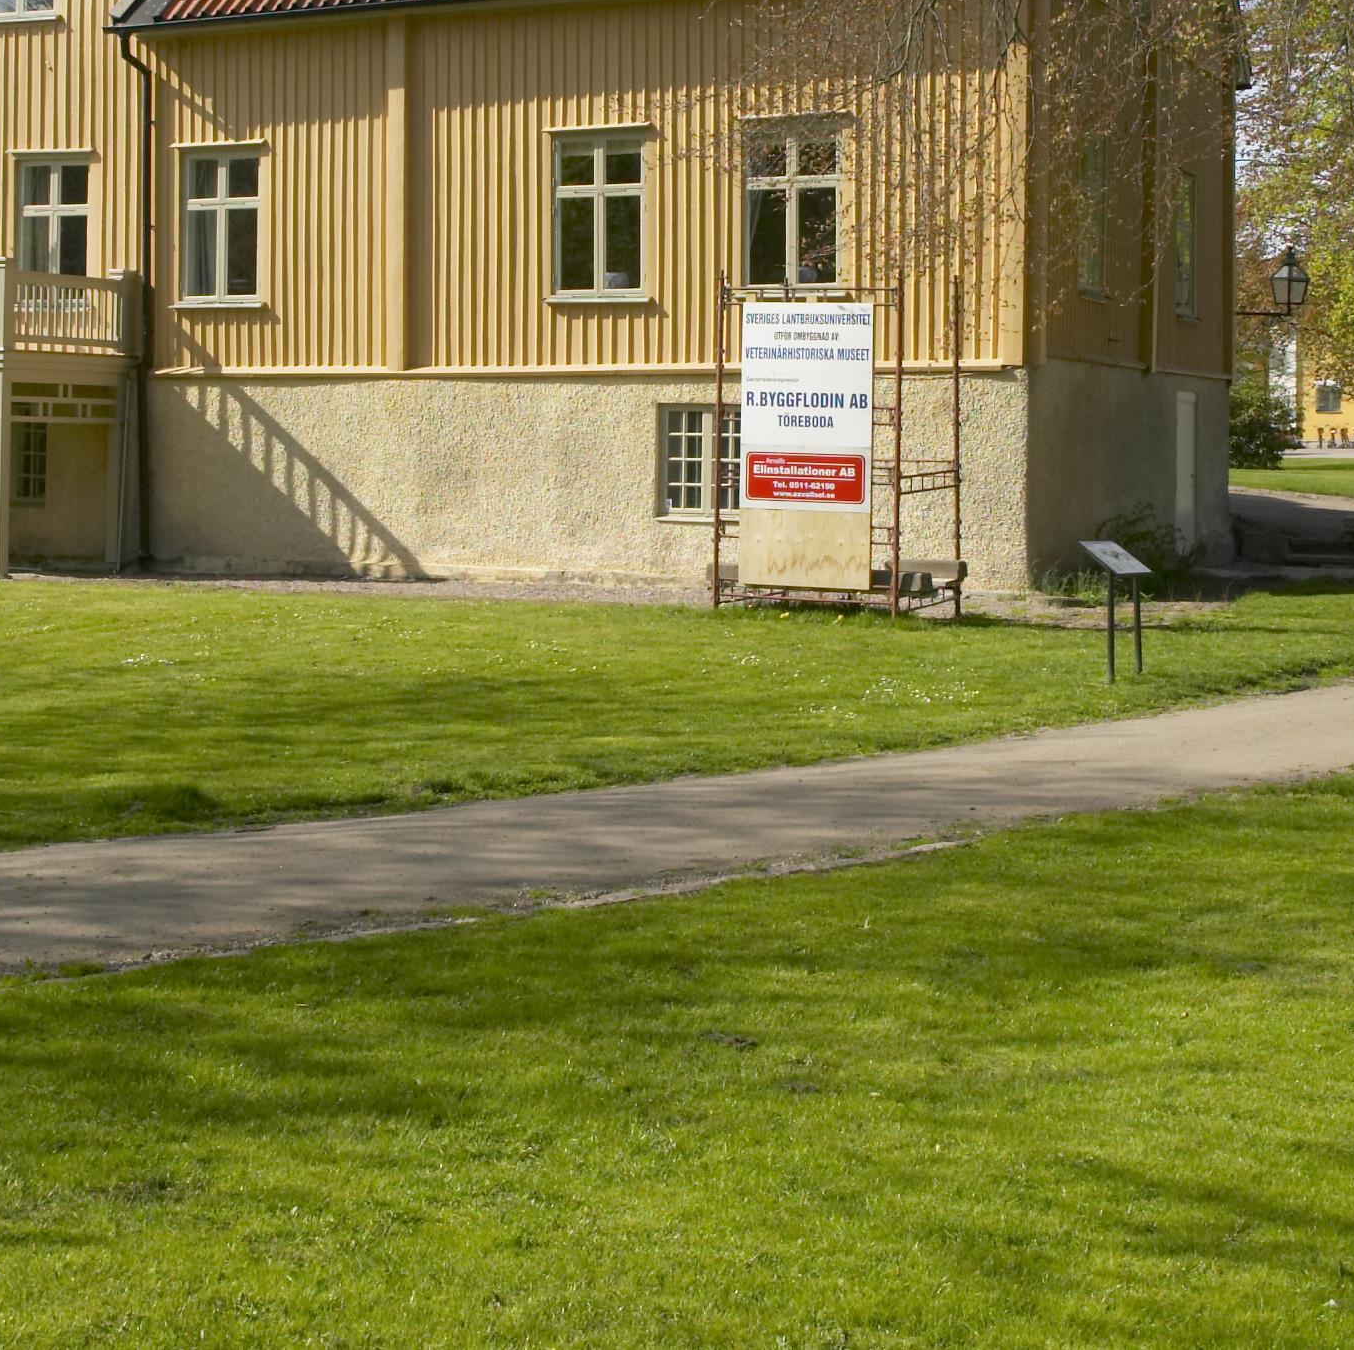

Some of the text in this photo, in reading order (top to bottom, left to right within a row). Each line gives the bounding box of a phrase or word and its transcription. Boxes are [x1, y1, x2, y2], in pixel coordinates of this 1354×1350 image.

[745, 313, 871, 325] SVERIGES LANTBRUKSUNIVERSITET
[793, 331, 830, 341] OMBYGGNAD
[745, 345, 870, 361] VETERINÄRHISTORISKA MUSEET
[746, 391, 868, 409] R.BYGGFLODIN AB
[777, 412, 834, 428] TÖREBODA
[753, 464, 856, 477] Elinstallationer AB
